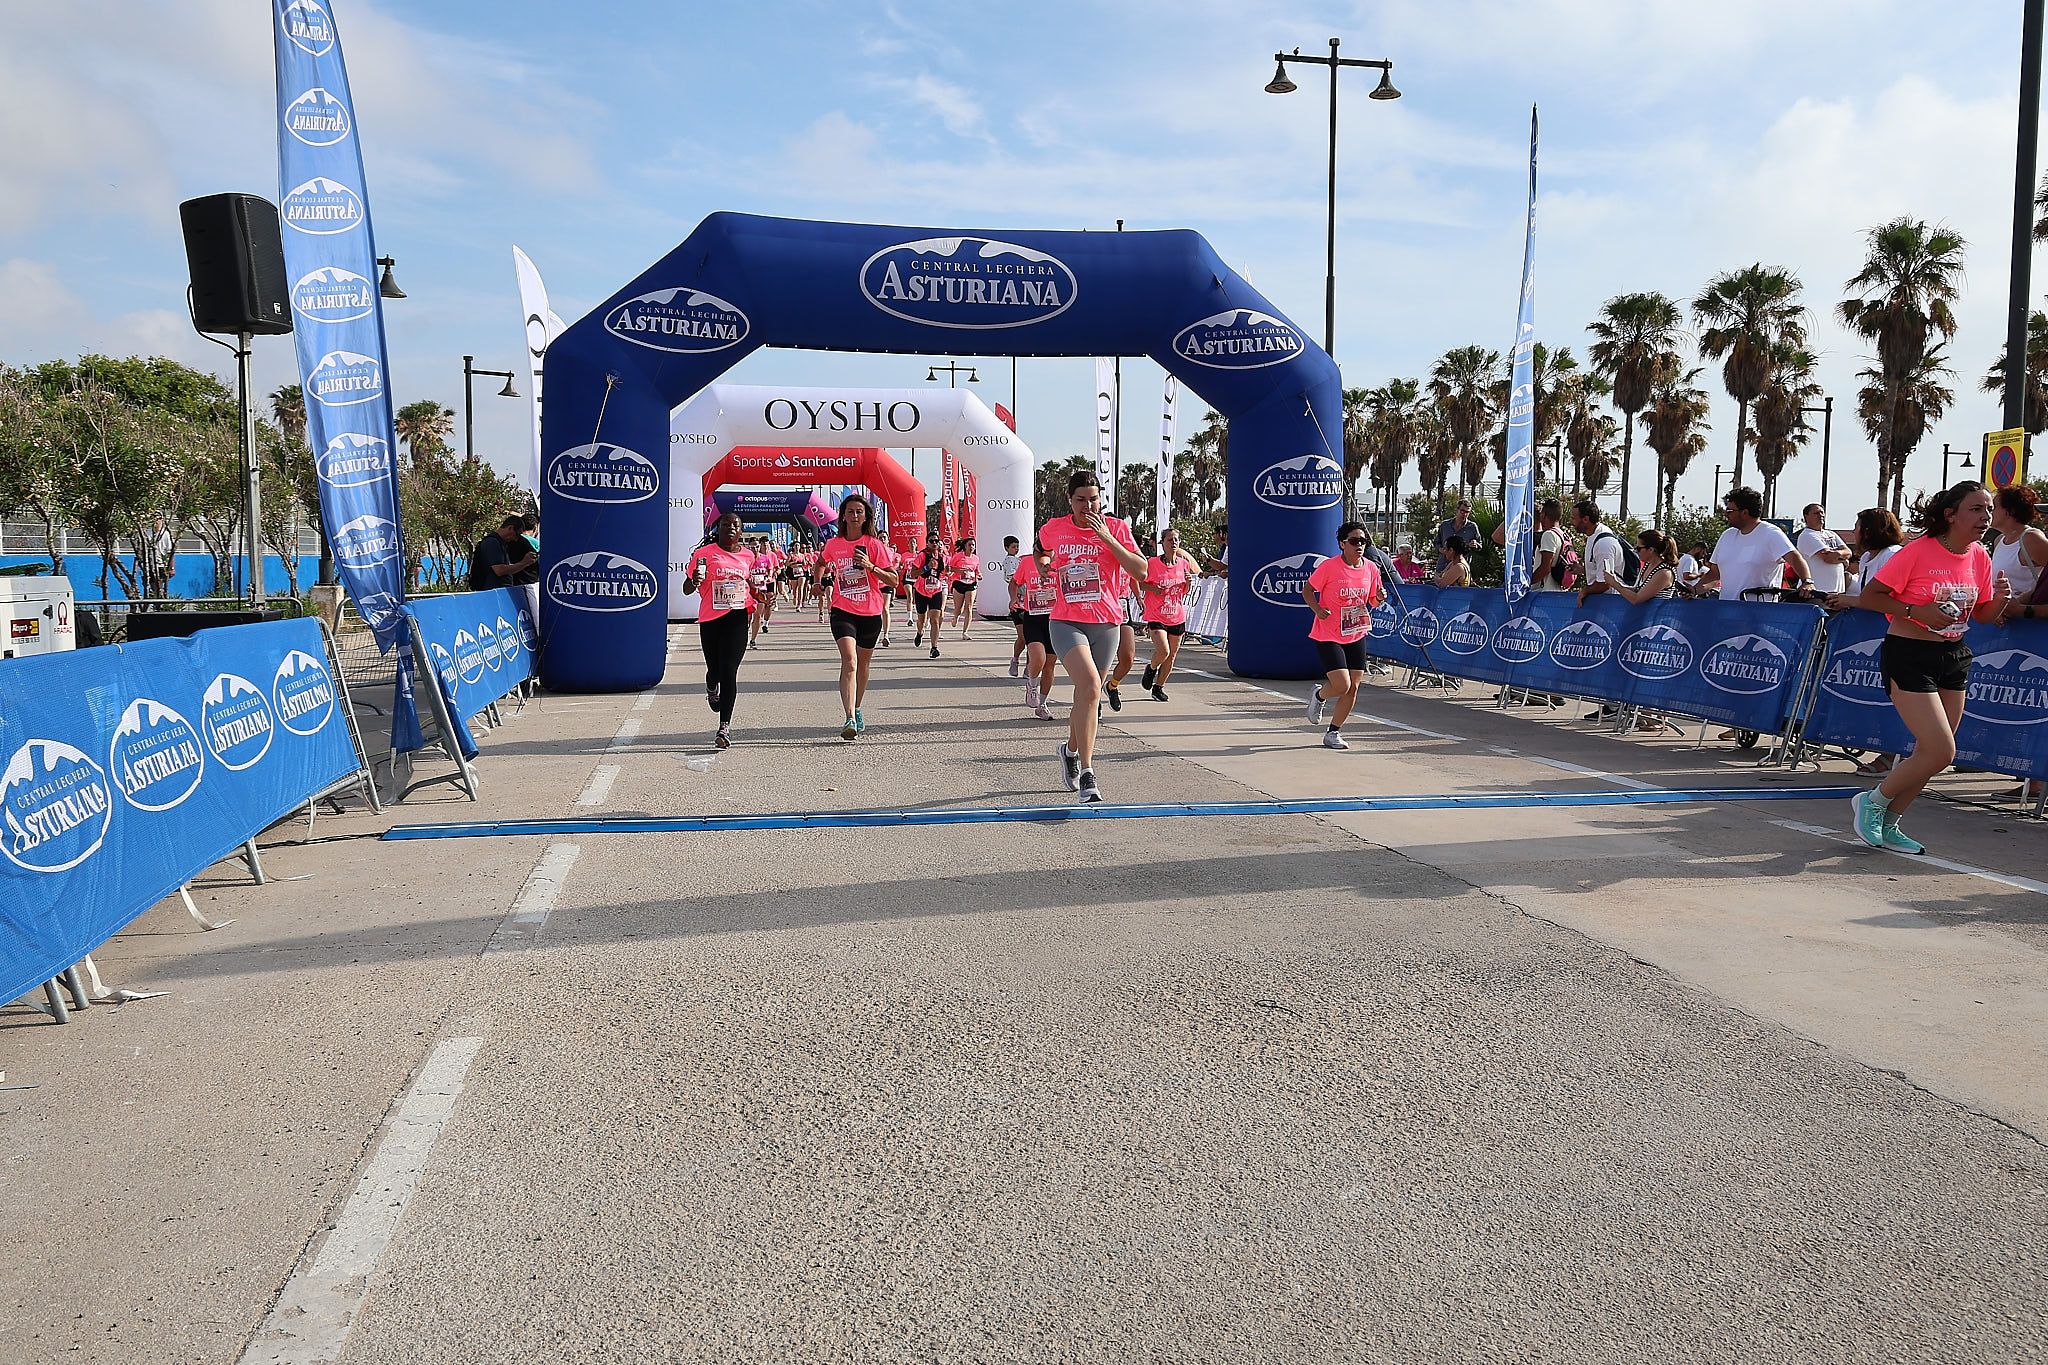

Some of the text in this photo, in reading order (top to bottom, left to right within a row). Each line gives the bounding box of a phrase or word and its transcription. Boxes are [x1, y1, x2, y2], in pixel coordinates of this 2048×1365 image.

[911, 260, 1054, 276] CENTRAL LECHERA
[876, 260, 1061, 306] ASTURIANA
[613, 308, 738, 341] ASTURIANA
[638, 306, 738, 323] CENTRAL LECHERA
[1205, 327, 1290, 338] CENTRAL LECHERA
[1184, 334, 1298, 356] ASTURIANA
[764, 399, 921, 433] OYSHO
[669, 433, 718, 445] OYSHO
[964, 434, 1009, 447] OYSHO
[568, 462, 650, 474] CENTRAL LECHERA
[733, 455, 856, 469] Sports Santander
[553, 463, 653, 491] ASTURIANA
[669, 498, 694, 508] SHO
[987, 499, 1029, 510] OYSHO
[1059, 544, 1099, 556] CARRERA
[551, 572, 651, 598] ASTURIANA
[567, 571, 649, 581] CENTRAL LECHERA
[1494, 631, 1539, 653] ASTURIANA
[1553, 637, 1605, 659] ASTURIANA
[1621, 642, 1685, 669] ASTURIANA
[1704, 652, 1779, 684] ASTURIANA
[1824, 659, 1885, 689] ASTUR
[1973, 671, 2016, 682] CENTRAL
[1966, 682, 2048, 709] STURIAN
[208, 709, 271, 754] ASTURIANA
[128, 734, 158, 756] CENTRAL
[122, 739, 201, 796] ASTURIANA
[17, 784, 55, 809] CENTRAL
[5, 782, 107, 856] ASTURIANA
